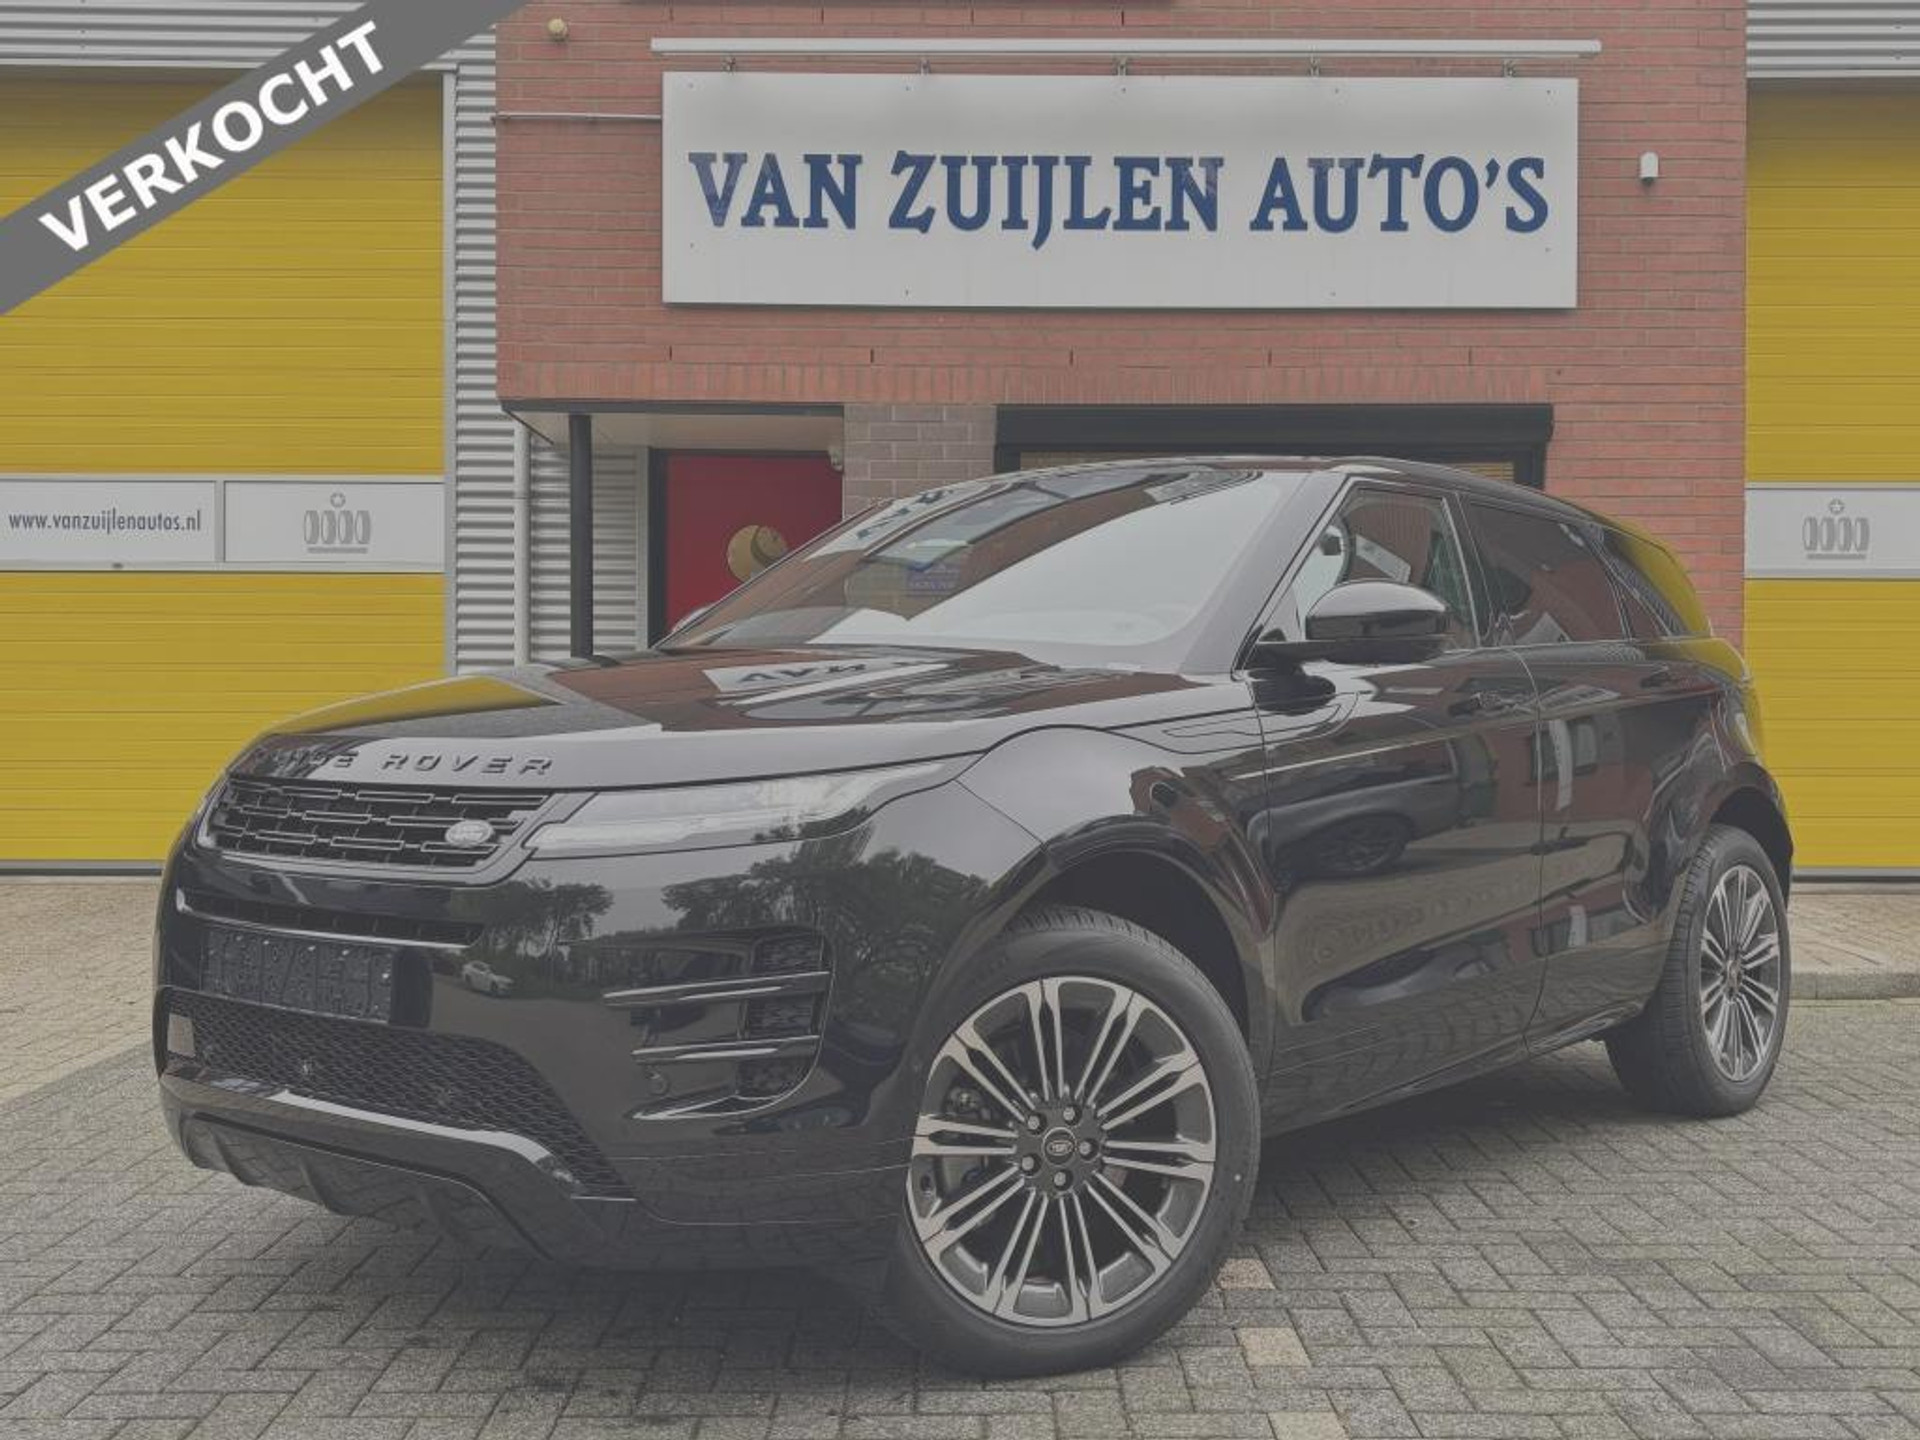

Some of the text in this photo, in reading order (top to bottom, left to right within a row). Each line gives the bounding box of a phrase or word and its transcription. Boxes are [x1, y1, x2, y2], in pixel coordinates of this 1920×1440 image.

[688, 150, 1550, 250] VAN ZUIJLEN AUTO'S
[8, 506, 201, 535] www.vanzuijlenautos.nl
[380, 754, 553, 776] ROVER
